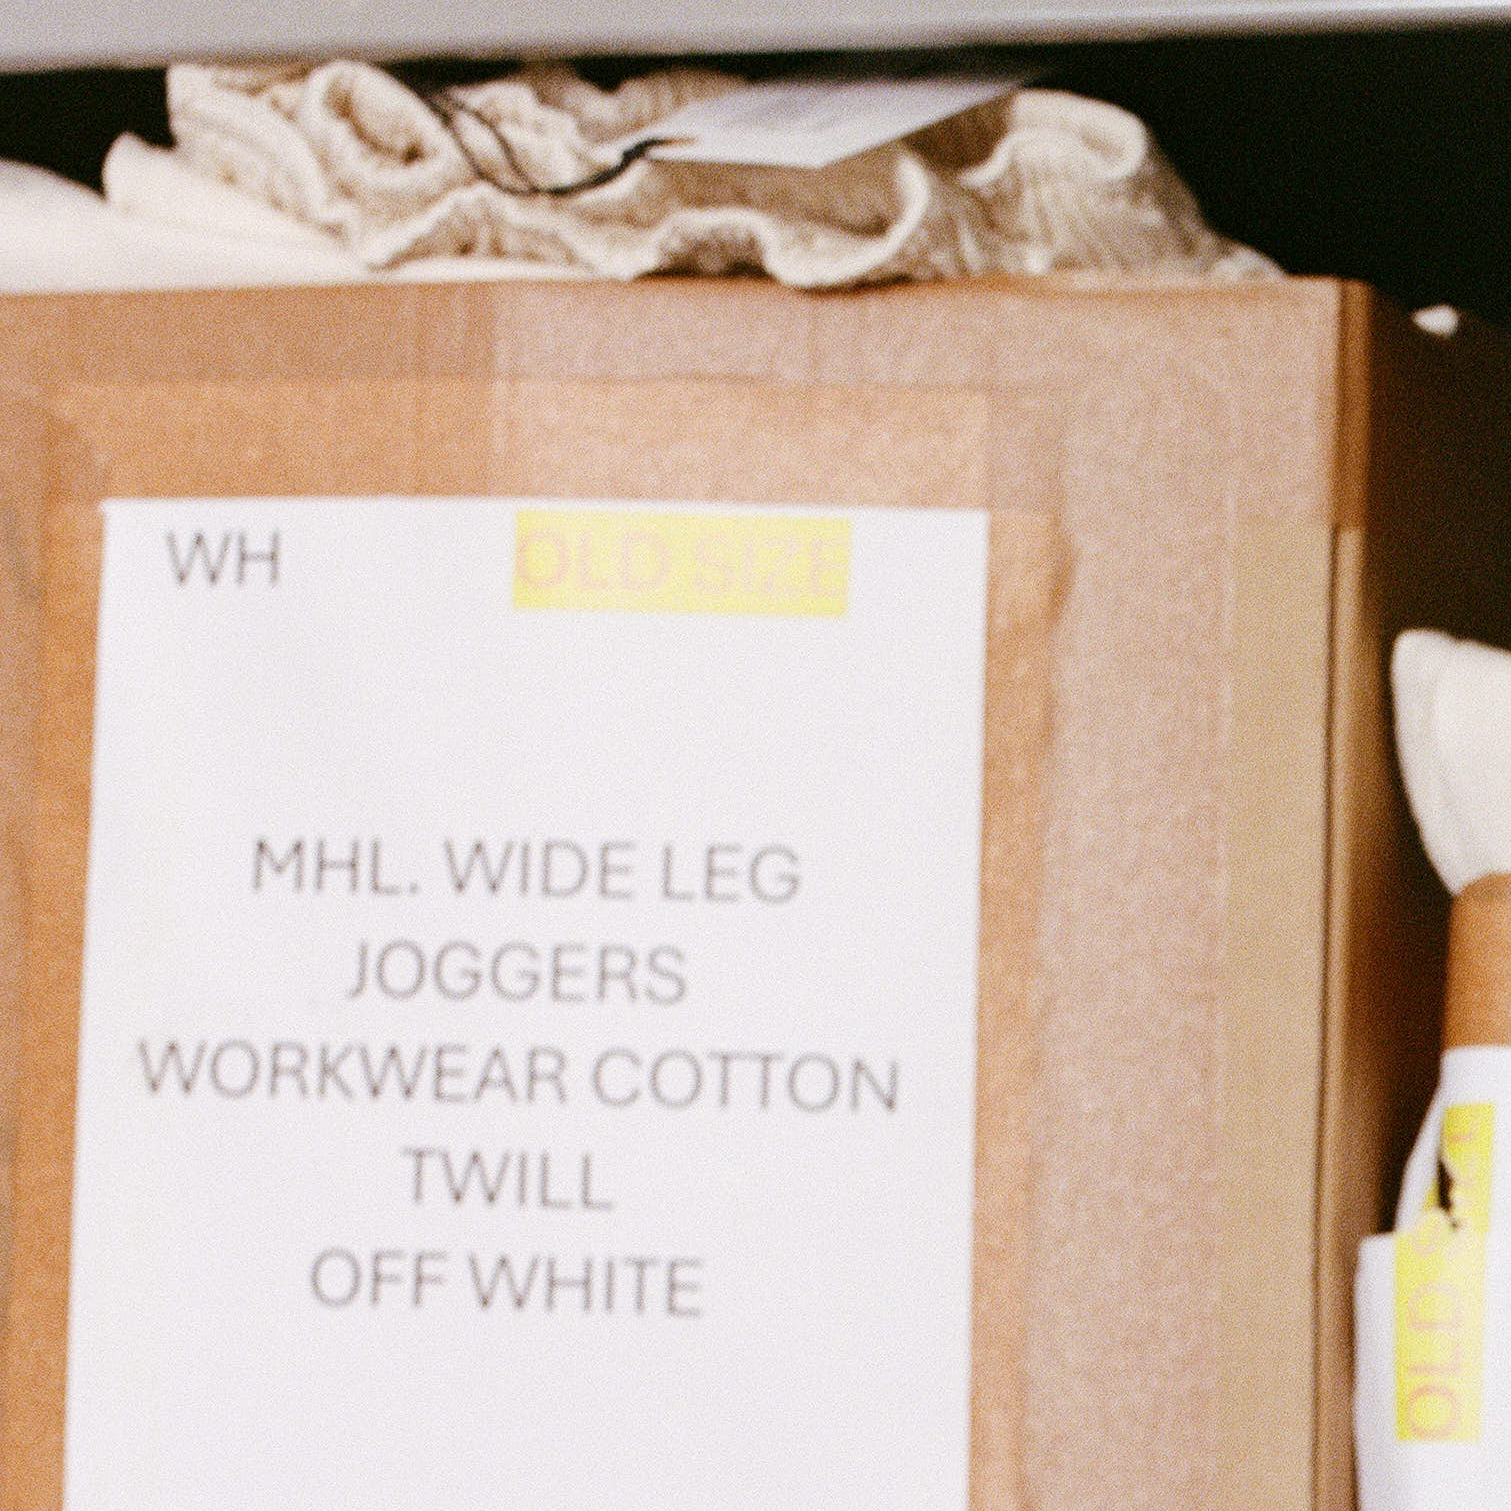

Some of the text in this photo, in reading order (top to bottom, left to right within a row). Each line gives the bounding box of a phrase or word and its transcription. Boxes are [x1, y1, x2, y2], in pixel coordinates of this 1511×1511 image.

[166, 526, 850, 599] WH OLD SIZE
[250, 834, 804, 908] MHL. WIDE LEG
[346, 936, 689, 1008] JOGGERS
[137, 1038, 902, 1115] WORKWEAR COTTON
[401, 1144, 615, 1213] TWILL
[308, 1245, 707, 1320] OFF WHITE
[1404, 1281, 1464, 1442] OLD
